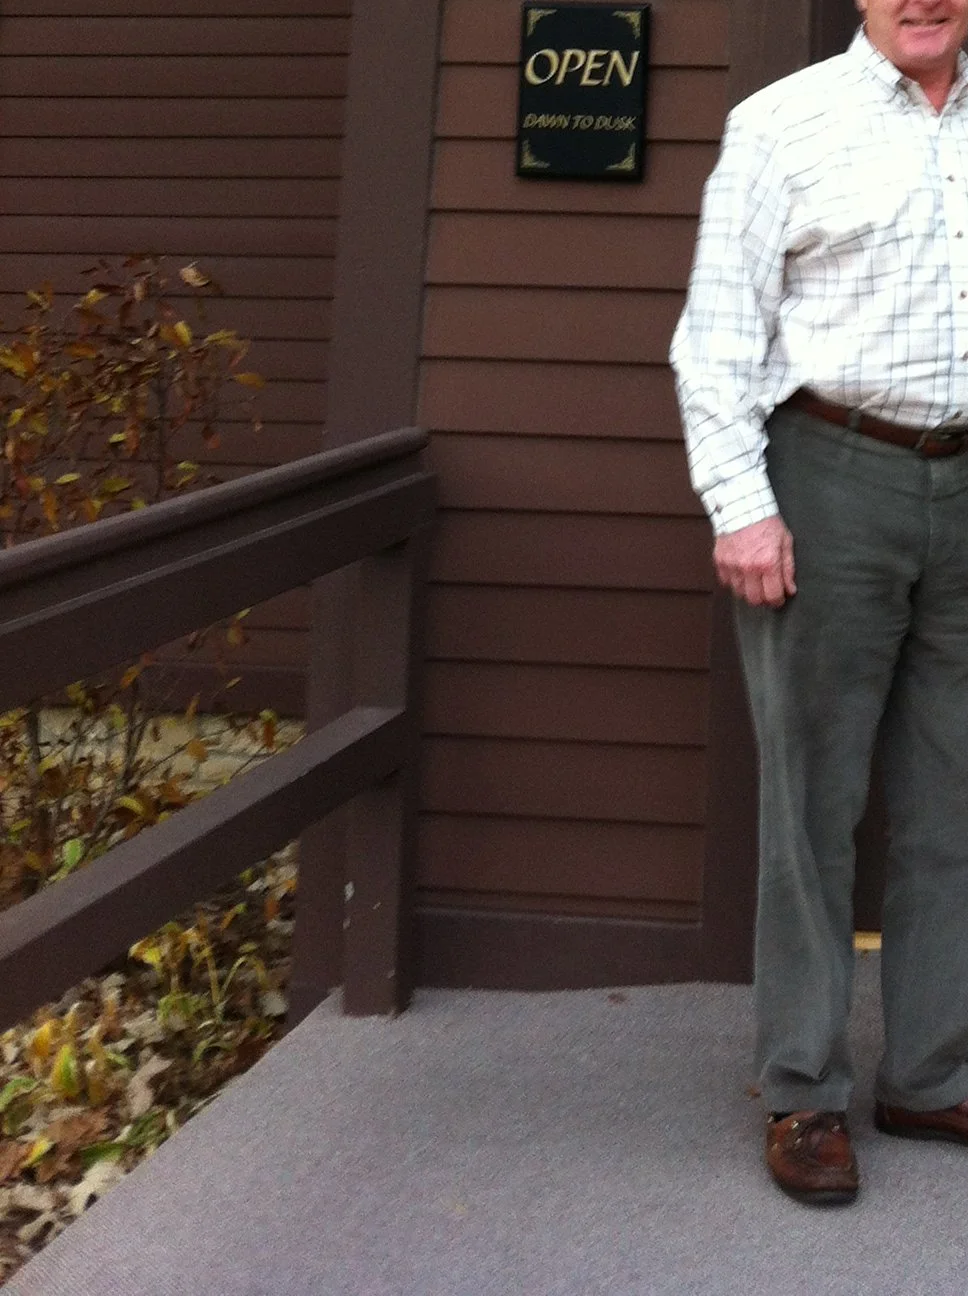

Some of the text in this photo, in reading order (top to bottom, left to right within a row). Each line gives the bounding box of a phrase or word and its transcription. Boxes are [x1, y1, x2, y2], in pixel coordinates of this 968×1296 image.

[524, 48, 640, 88] OPEN
[522, 113, 636, 131] DAWN TO DUSK
